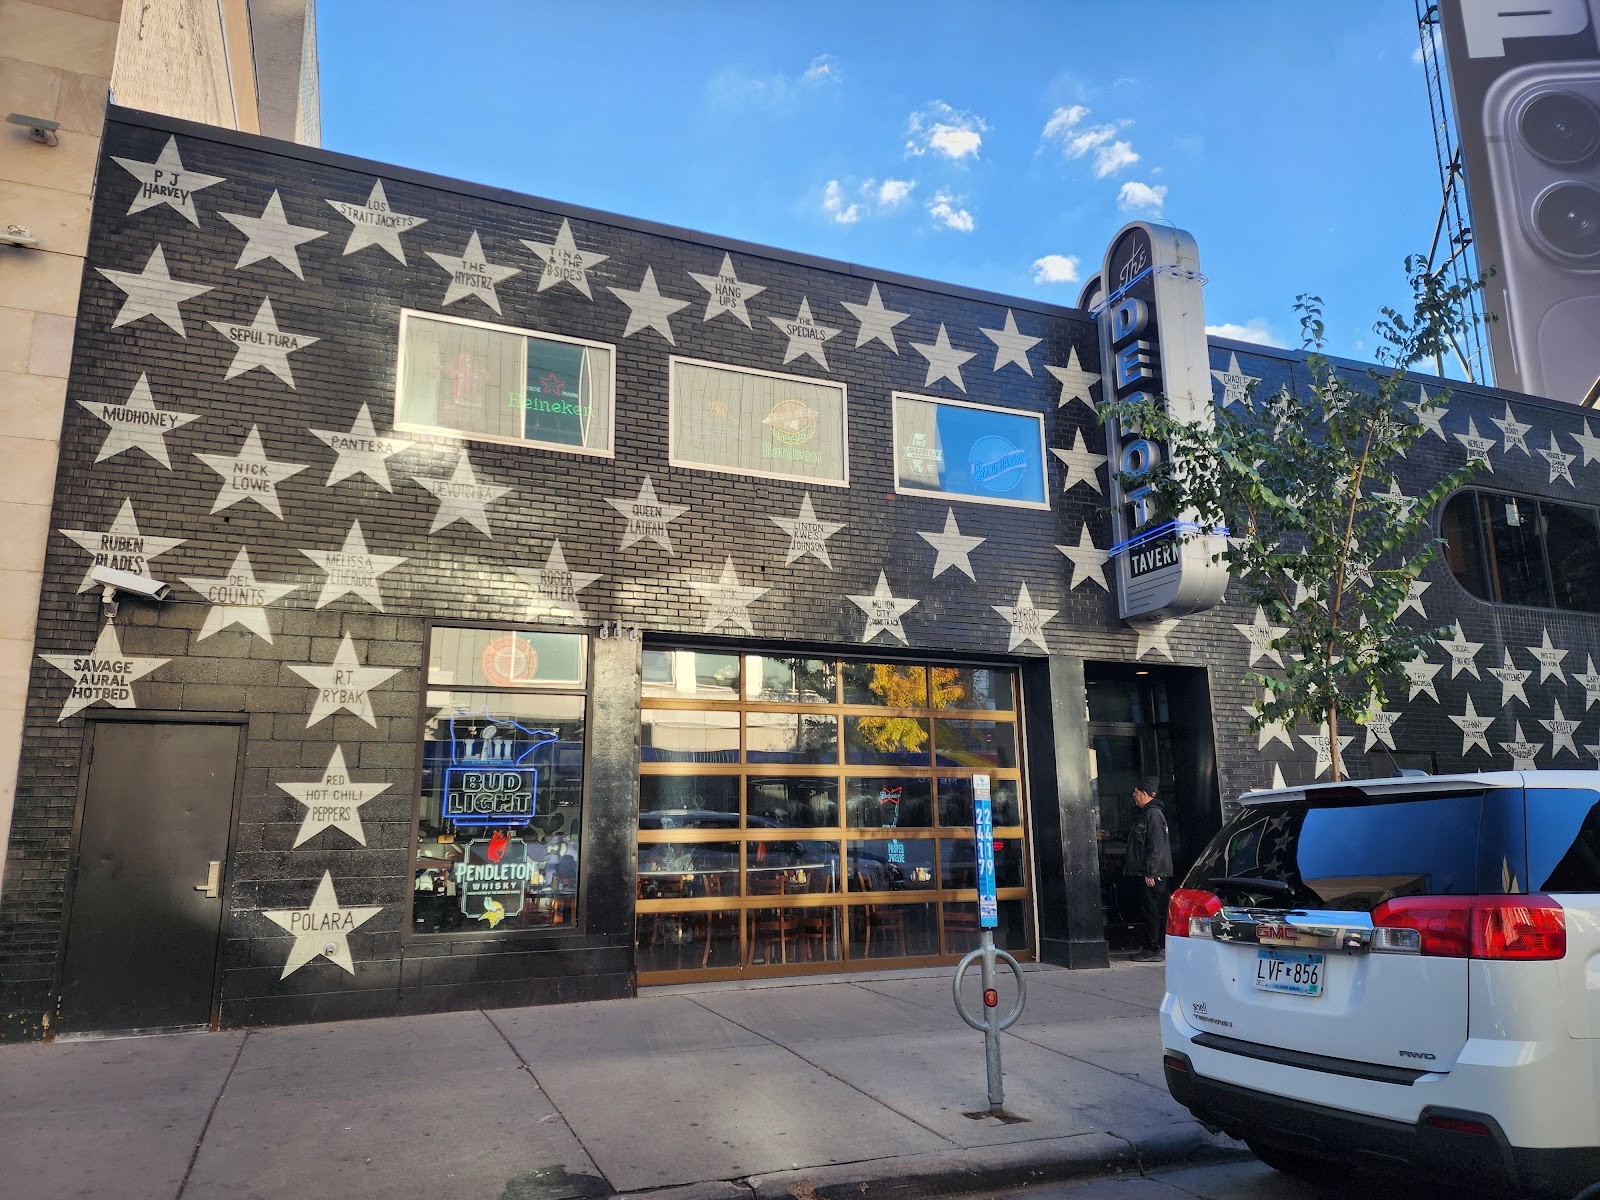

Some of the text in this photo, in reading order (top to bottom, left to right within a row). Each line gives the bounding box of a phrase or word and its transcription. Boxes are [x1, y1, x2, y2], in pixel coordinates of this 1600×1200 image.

[153, 169, 181, 187] P J
[143, 182, 191, 206] HARVEY
[367, 199, 386, 213] LOS
[549, 248, 583, 261] TINA
[1119, 237, 1147, 284] The
[460, 259, 487, 274] THE
[548, 255, 582, 270] & THE
[547, 263, 583, 282] B-SIDES
[720, 275, 736, 284] THE
[454, 271, 493, 291] HYPSTRZ
[714, 283, 741, 298] HANG
[719, 295, 737, 308] UPS
[798, 316, 812, 325] THE
[229, 327, 299, 349] SEPULTURA
[786, 324, 826, 341] SPECIALS
[1223, 373, 1249, 385] CRADLE
[1226, 389, 1244, 400] FILT
[508, 392, 595, 418] Heineken
[102, 405, 179, 429] MUDHONEY
[330, 435, 394, 454] PANTERA
[907, 447, 941, 457] SURLY
[233, 462, 269, 477] NICK
[232, 477, 271, 493] LOWE
[632, 504, 662, 518] QUEEN
[629, 520, 664, 537] LATIFAH
[793, 521, 824, 533] LINTON
[793, 530, 823, 540] KWESI
[100, 534, 144, 553] RUBEN
[791, 540, 825, 552] JOHNSON
[325, 553, 373, 569] MELISSA
[1131, 542, 1179, 575] TAVERN
[229, 574, 251, 588] DEL
[329, 568, 376, 588] ETHERIDGE
[541, 569, 573, 586] ROGER
[208, 586, 267, 606] COUNTS
[872, 599, 895, 610] MOTION
[876, 609, 890, 618] CITY
[1012, 607, 1040, 621] BYRON
[1012, 621, 1041, 635] FRANK
[1249, 626, 1274, 639] SONNY
[1252, 638, 1272, 650] KNIG
[73, 658, 133, 674] SAVAGE
[78, 674, 129, 687] AURAL
[71, 687, 130, 701] HOTBED
[321, 689, 365, 705] RYBAK
[1311, 736, 1343, 746] TEGN
[1465, 732, 1485, 740] WINTER
[326, 775, 345, 786] RED
[462, 772, 522, 792] BUD
[306, 789, 363, 801] HOT CHILI
[448, 792, 532, 815] LIGHT
[312, 806, 351, 822] PEPPERS
[455, 861, 535, 884] PENDLETON
[472, 881, 518, 891] WHISKY
[291, 912, 355, 932] POLARA
[1255, 925, 1298, 941] GMC
[1257, 960, 1318, 985] LVF 856
[1256, 979, 1266, 987] DEC
[1399, 1050, 1436, 1061] AWD
